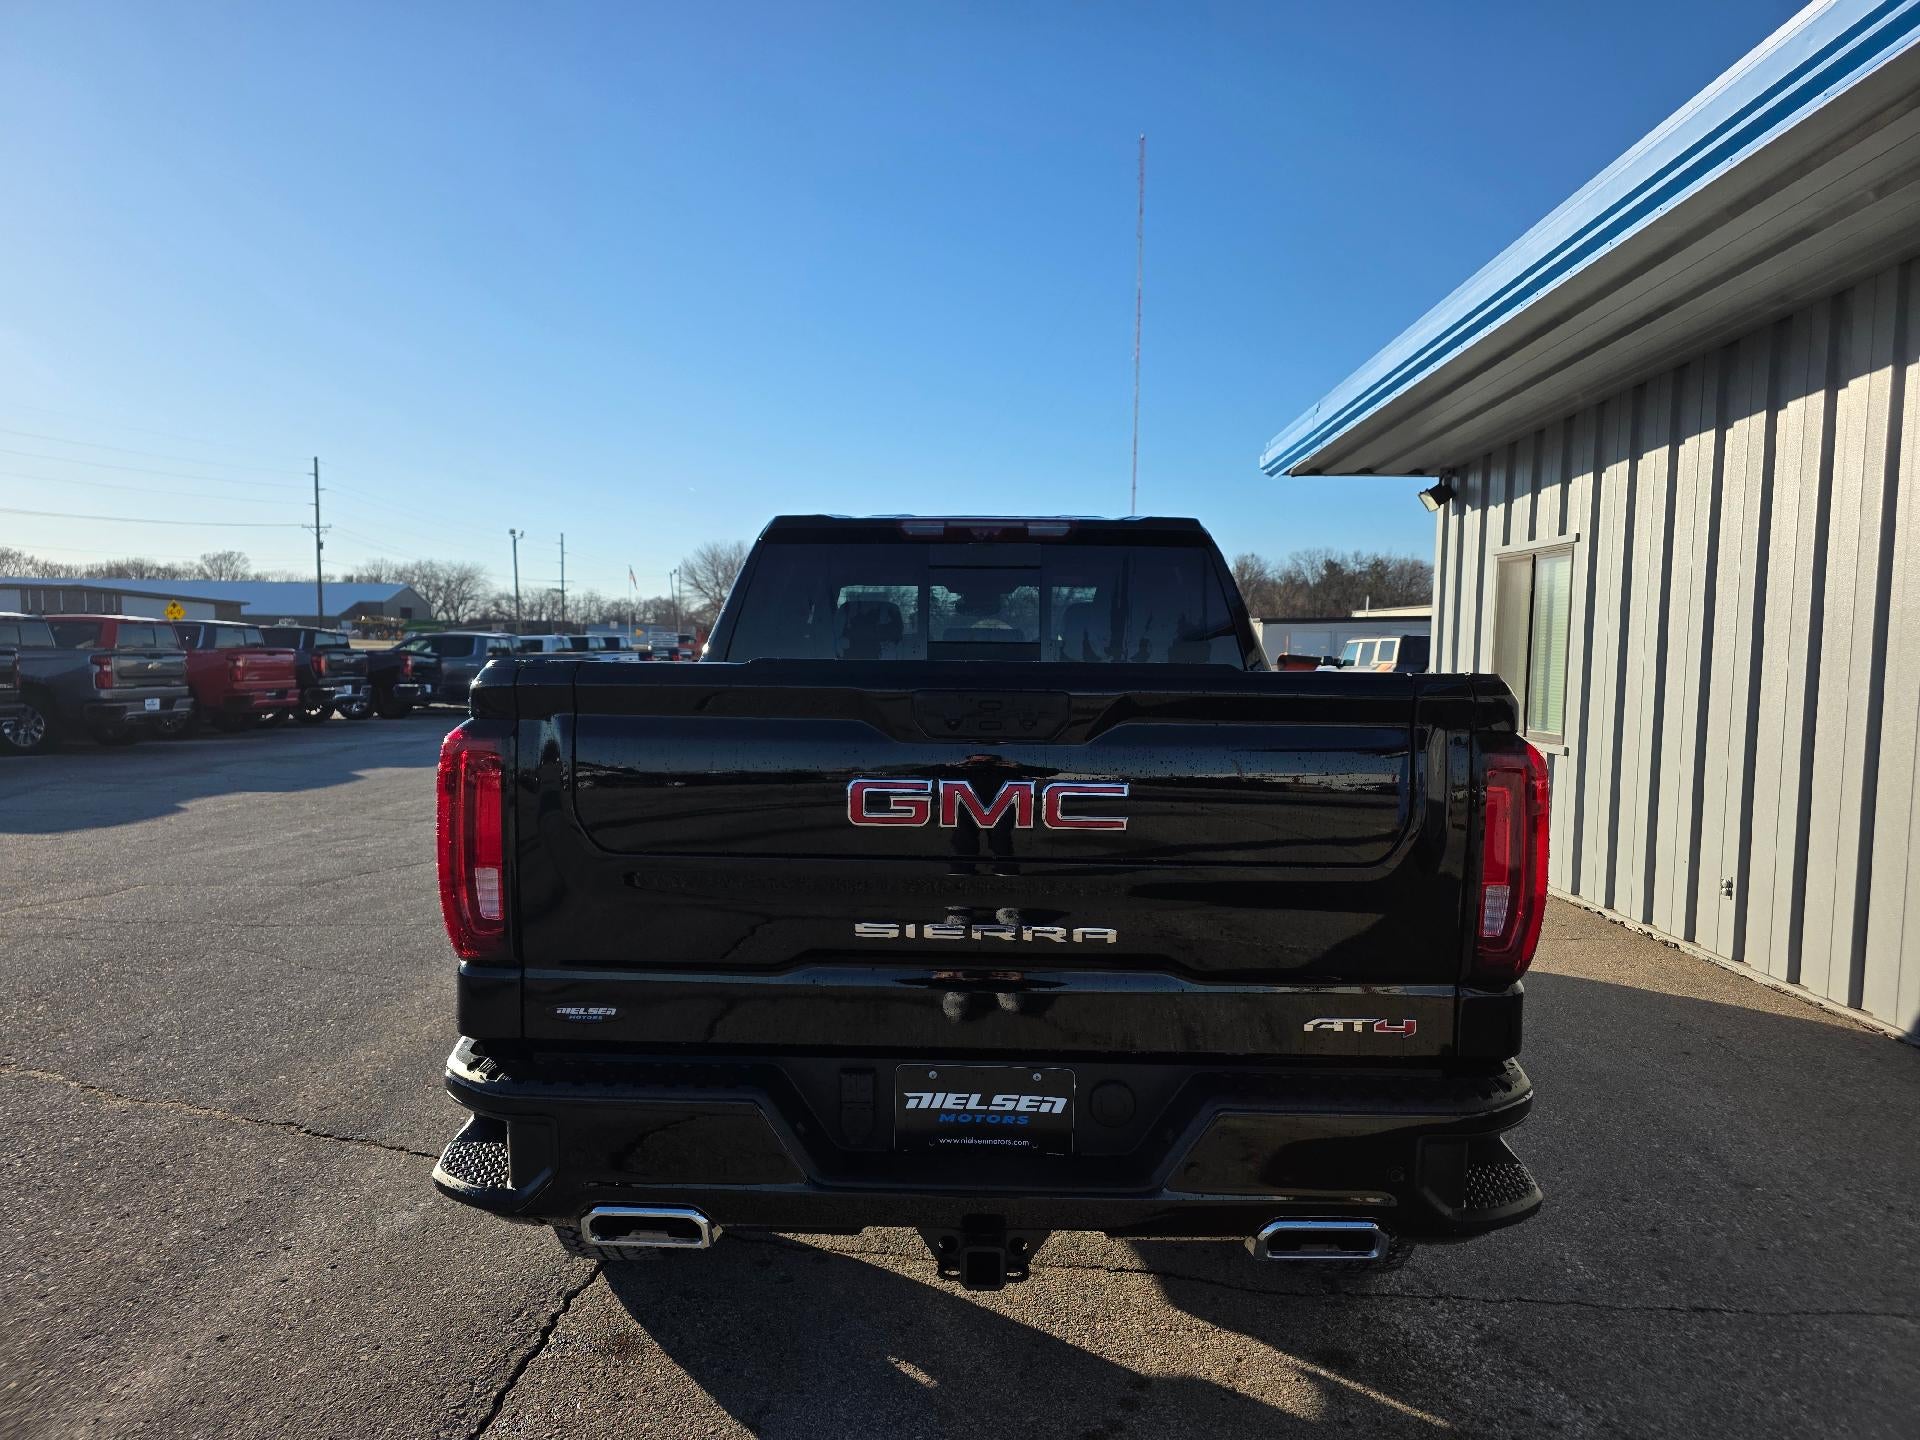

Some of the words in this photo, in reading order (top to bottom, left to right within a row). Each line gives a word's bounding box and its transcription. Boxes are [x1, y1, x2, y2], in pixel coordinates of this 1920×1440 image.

[847, 777, 1130, 831] GMC
[854, 922, 1117, 944] SIERRA
[556, 1007, 617, 1015] NIELSEN
[1303, 1018, 1417, 1038] AT4
[904, 1092, 1067, 1114] NIELSEN
[938, 1113, 1031, 1125] MOTORS
